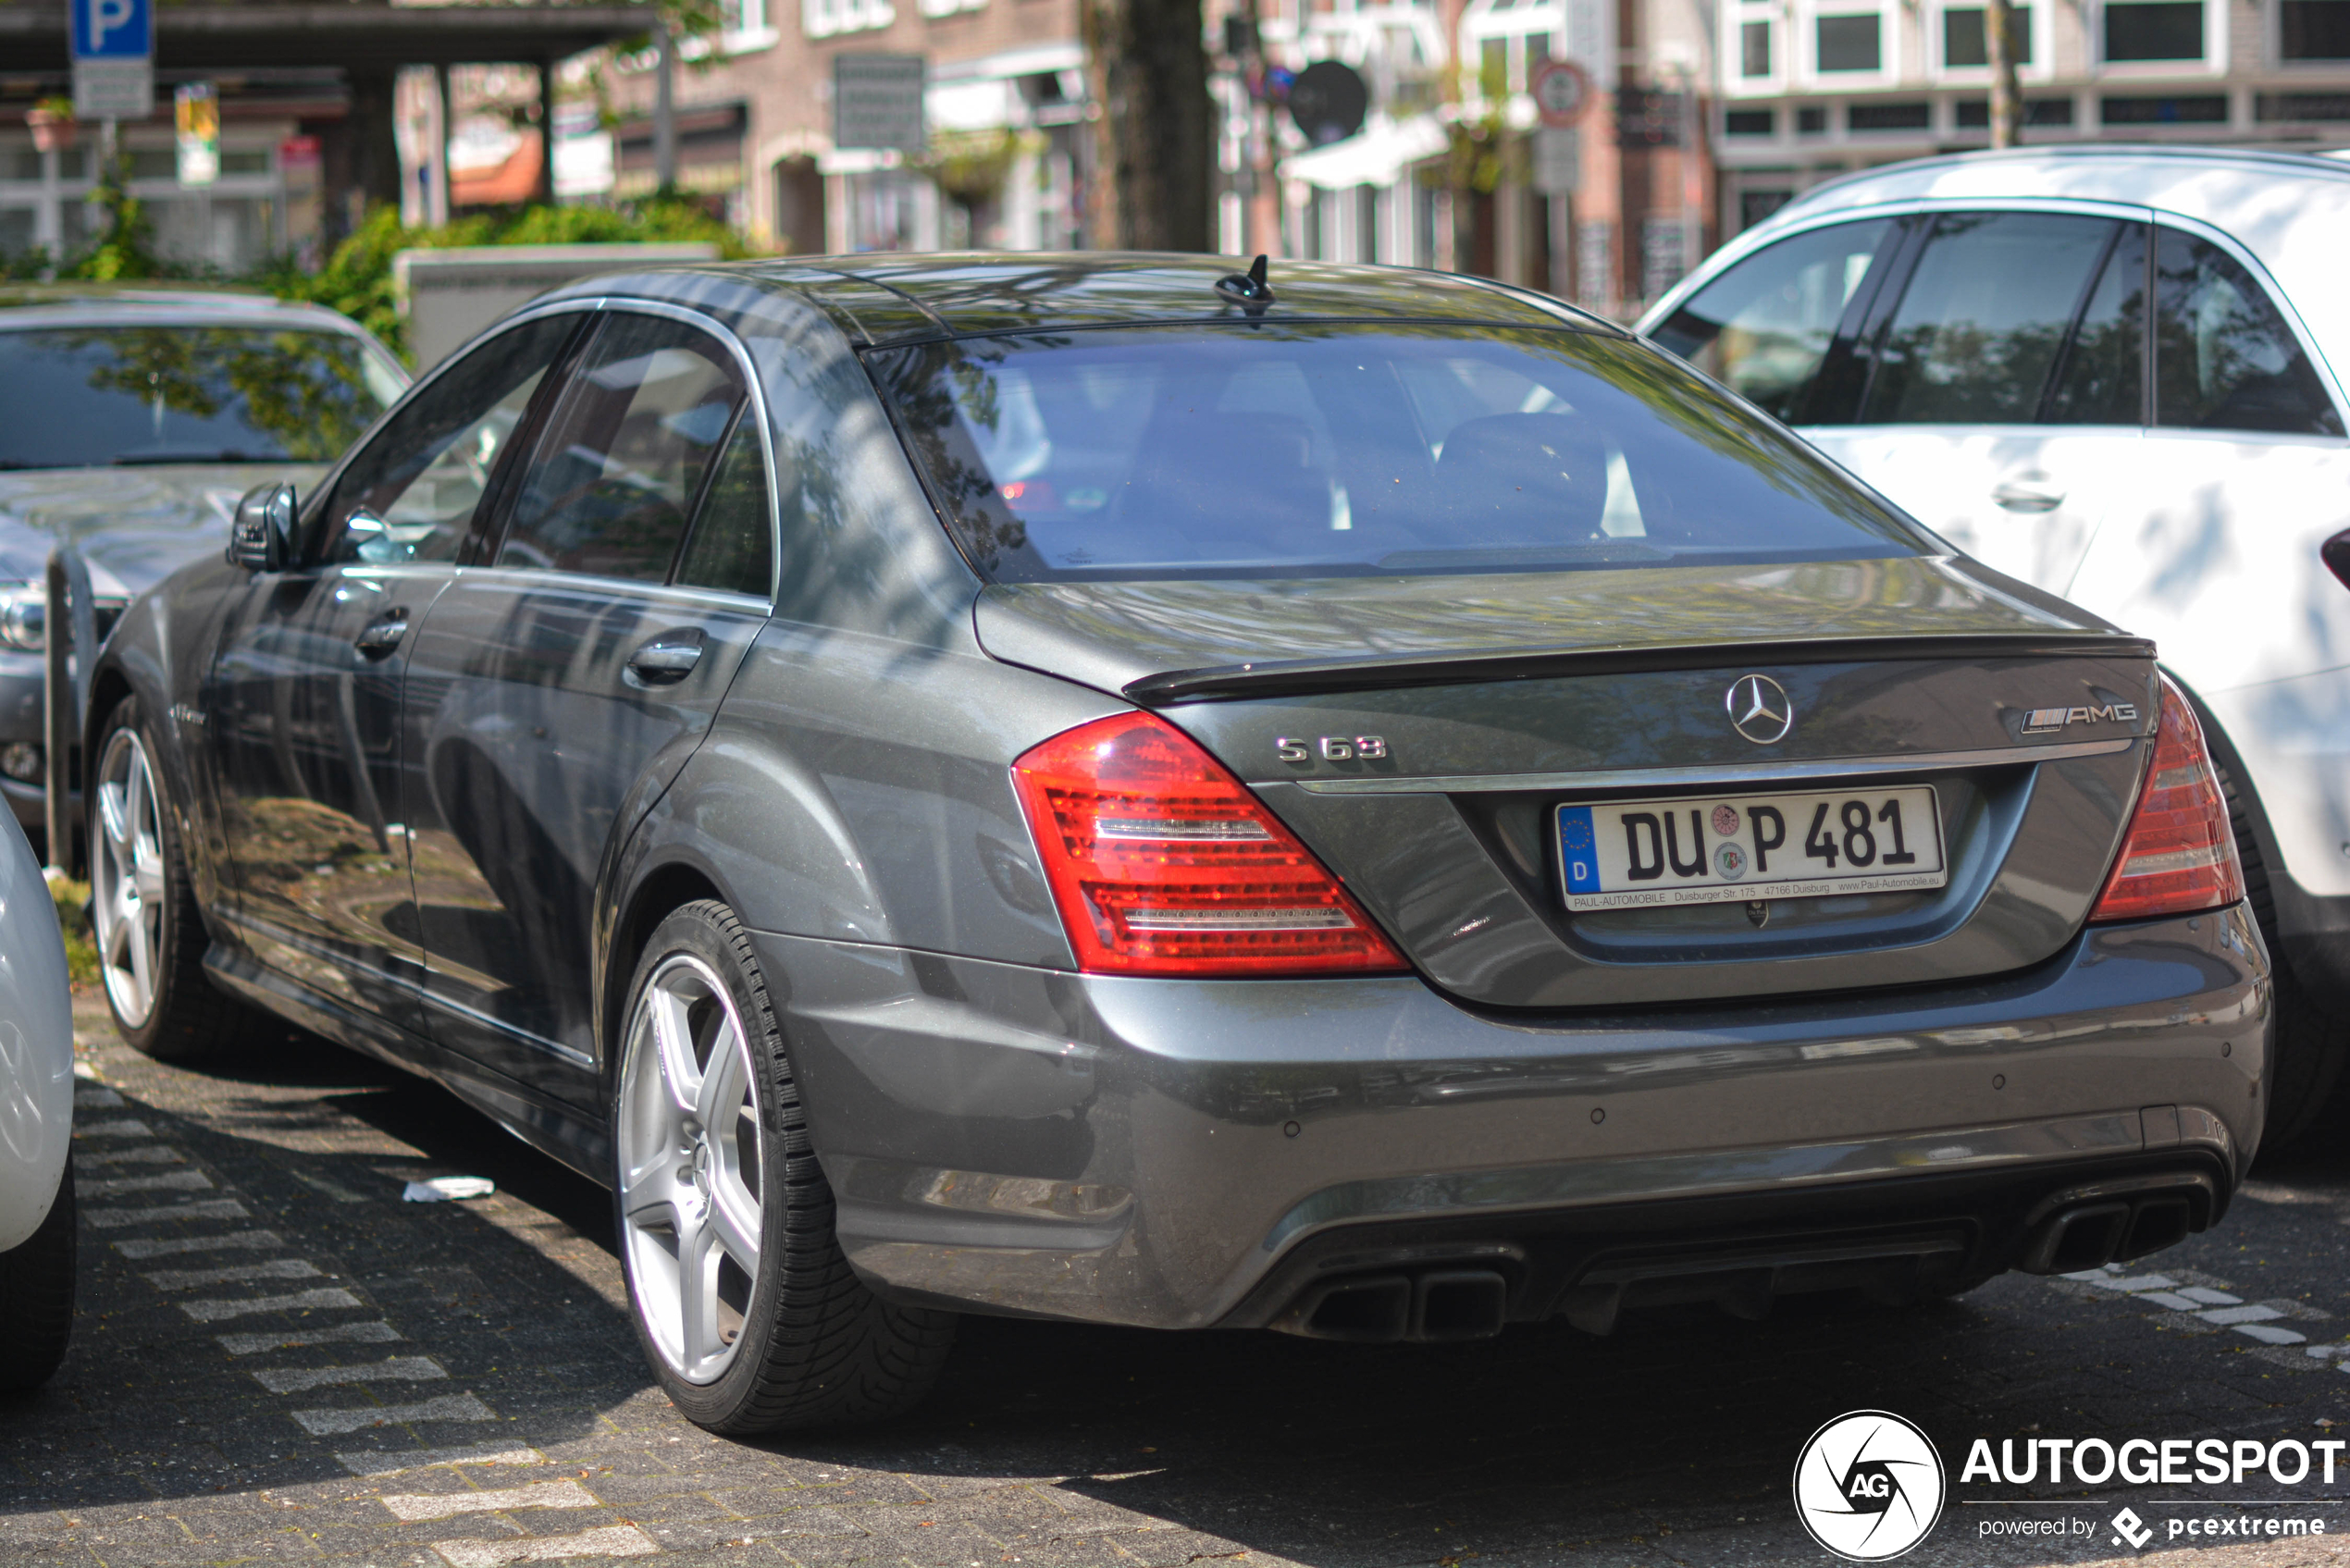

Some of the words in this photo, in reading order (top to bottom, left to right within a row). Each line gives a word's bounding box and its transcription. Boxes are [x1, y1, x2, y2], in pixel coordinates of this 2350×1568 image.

[90, 0, 134, 52] P
[2065, 704, 2137, 724] AMG
[1277, 737, 1307, 762] S
[1319, 735, 1387, 760] 63
[1621, 809, 1709, 882] DU
[1748, 806, 1787, 872] P
[1804, 799, 1916, 872] 481
[1574, 861, 1588, 882] D
[1574, 893, 1665, 908] PAUL-AUTOMOBILE
[1674, 890, 1722, 903] Duisburger
[1723, 888, 1738, 899] Str.
[1740, 886, 1756, 898] 175
[1764, 884, 1791, 895] 47166
[1792, 883, 1830, 895] Duisburg
[1837, 876, 1939, 891] www.Paul-Automobile.eu
